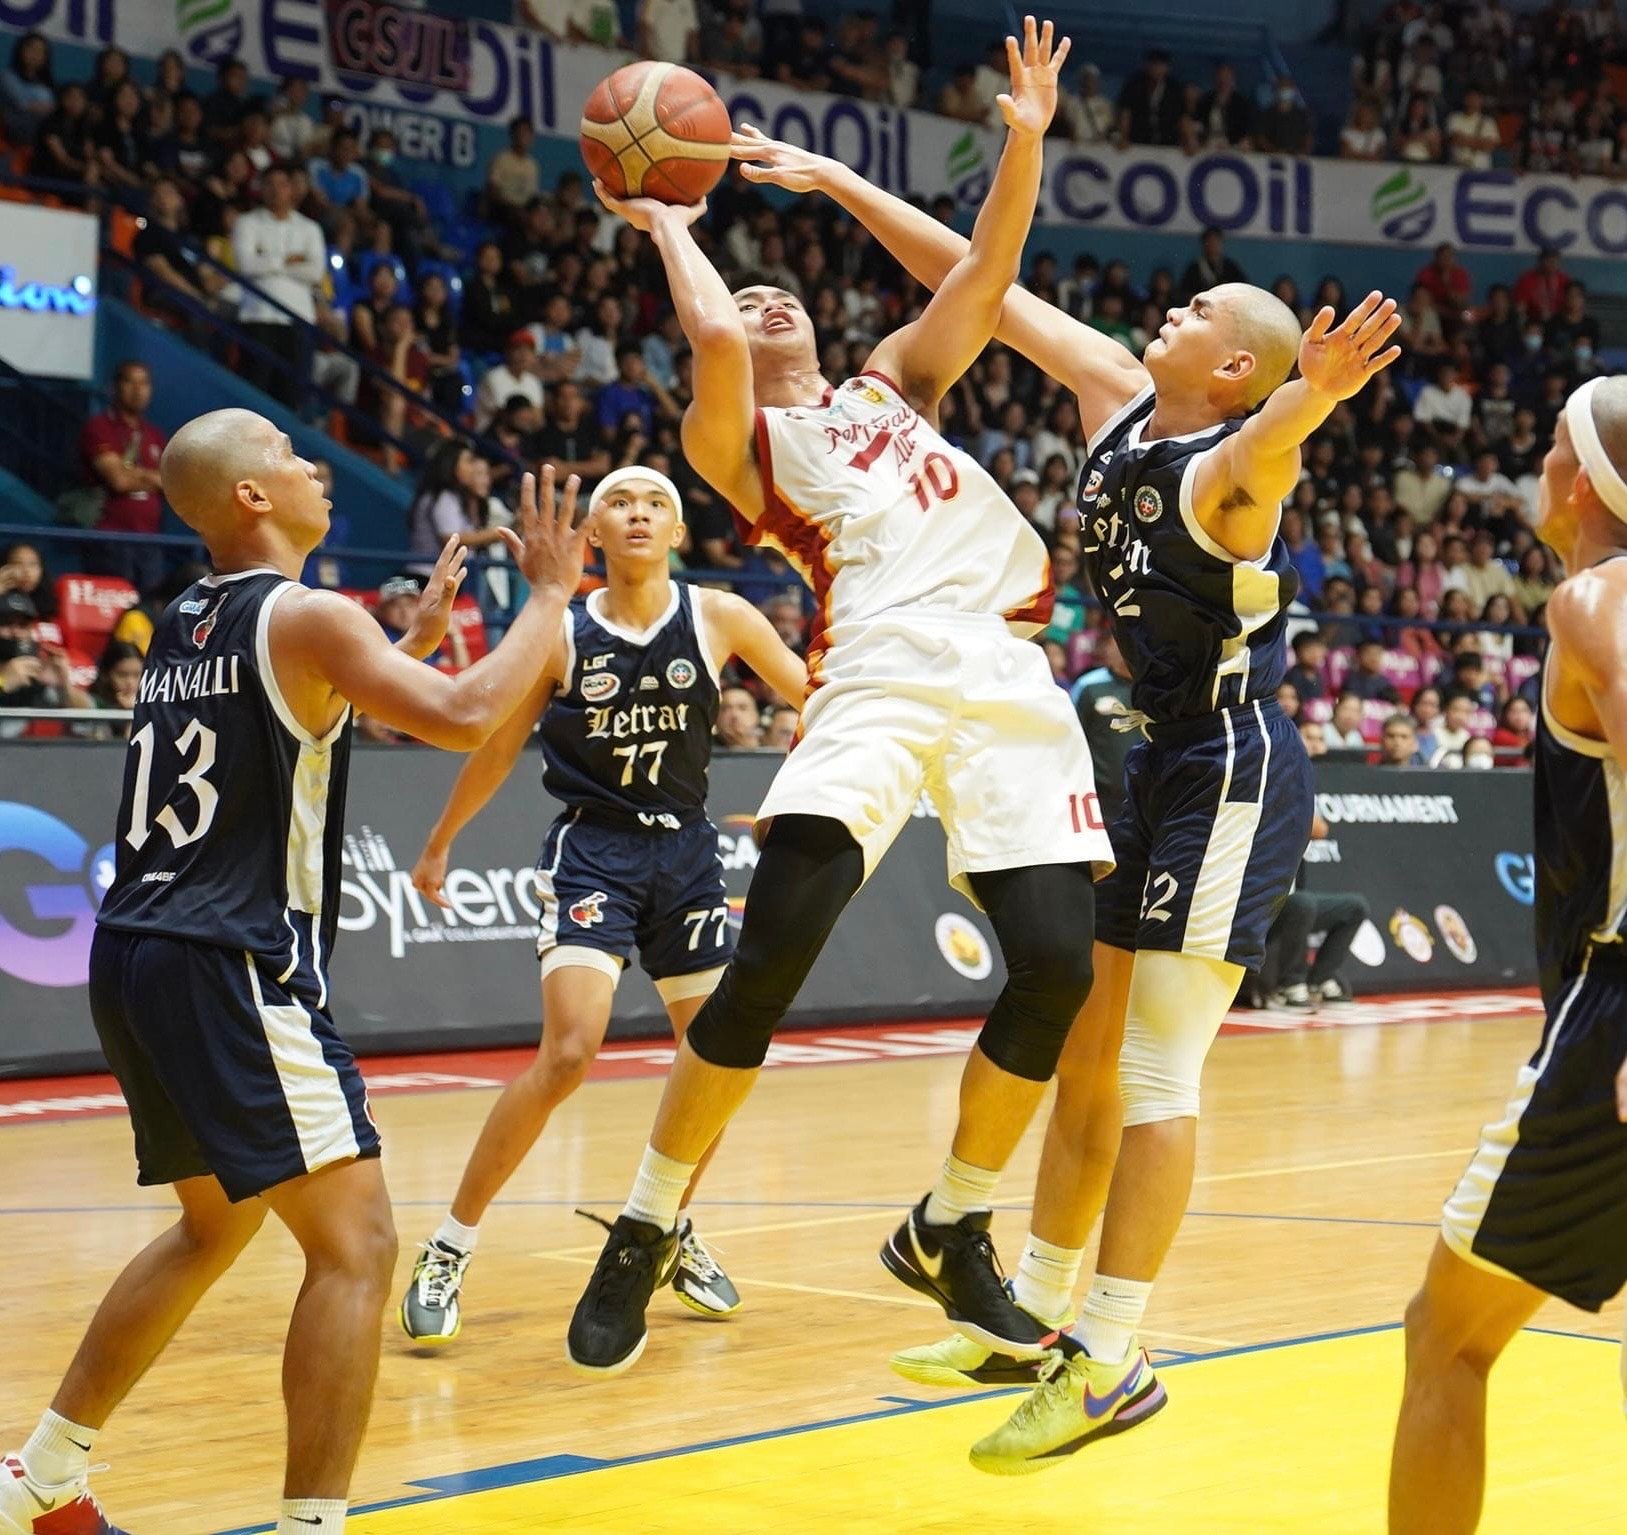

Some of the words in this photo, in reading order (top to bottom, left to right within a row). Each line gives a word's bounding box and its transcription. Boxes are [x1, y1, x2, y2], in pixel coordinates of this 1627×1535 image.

[1034, 154, 1313, 235] coOil
[908, 452, 959, 512] 10
[134, 655, 239, 704] MANALLI
[125, 718, 219, 851] 13
[613, 740, 669, 787] 77
[1069, 792, 1105, 833] 10
[1313, 793, 1459, 823] OURNAMENT
[1139, 869, 1180, 923] 2
[683, 906, 728, 951] 77
